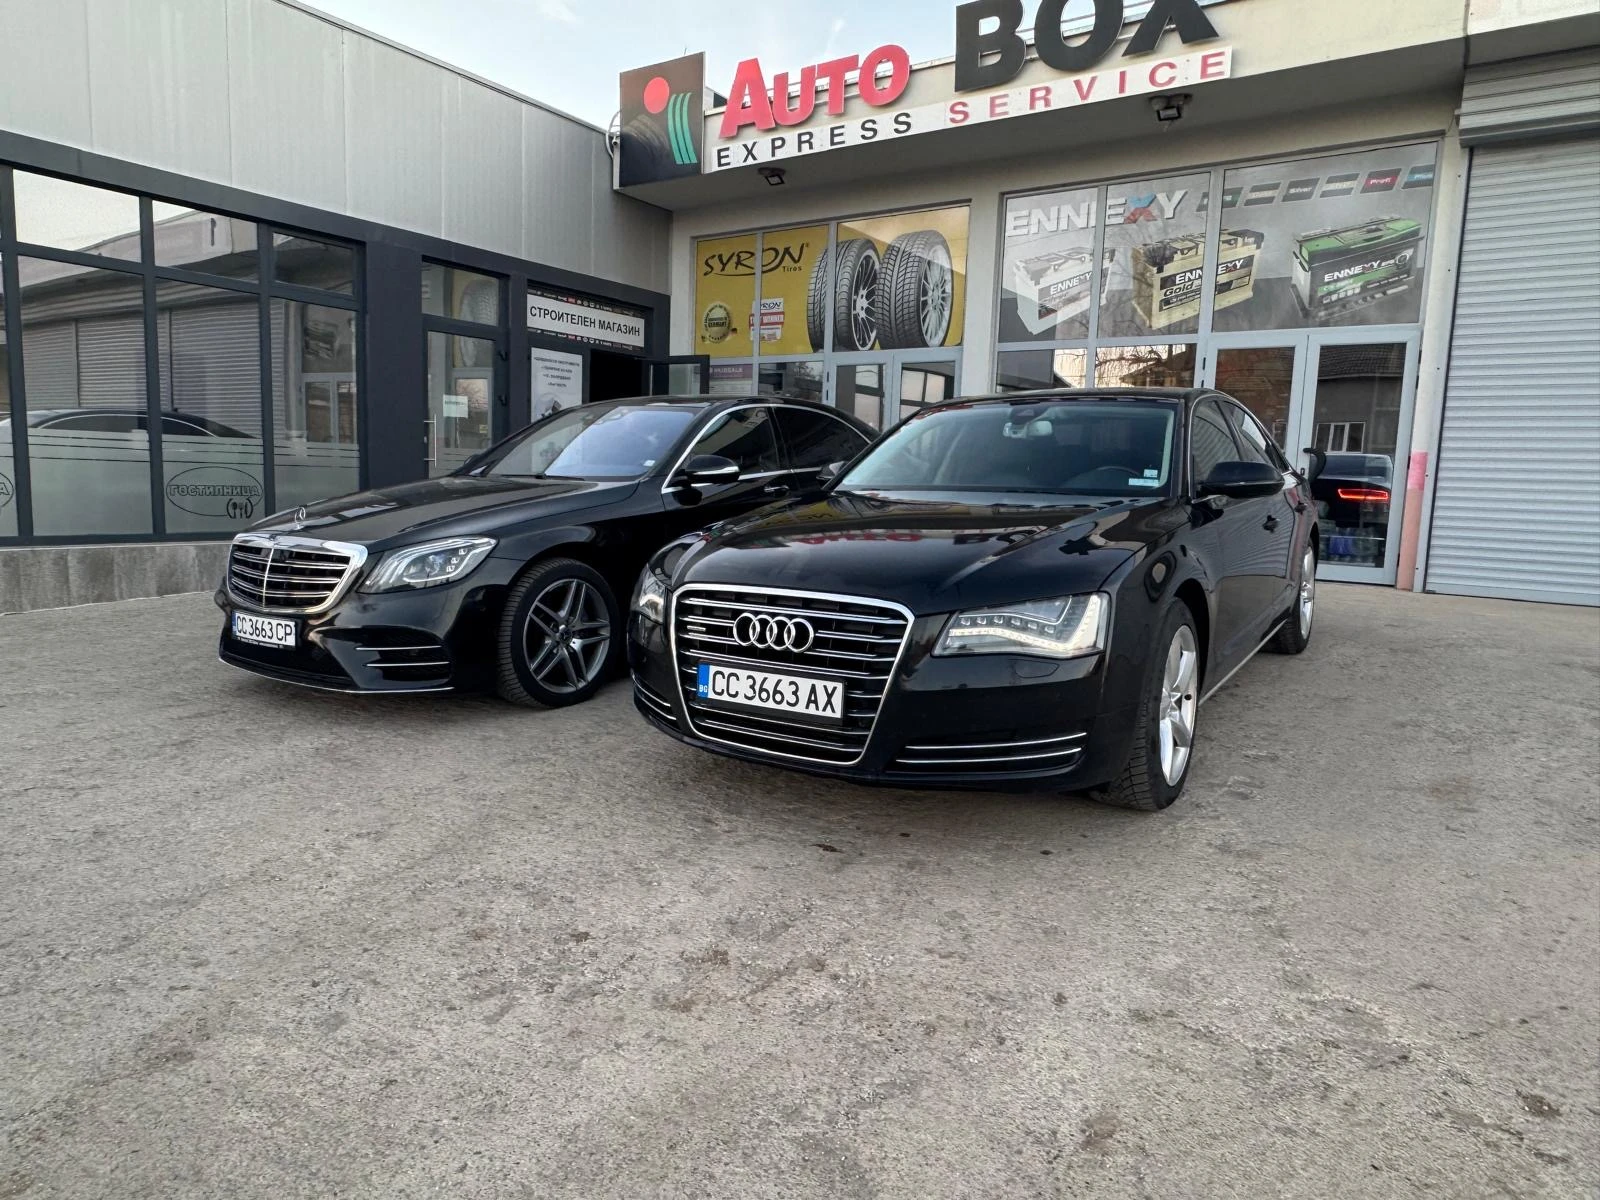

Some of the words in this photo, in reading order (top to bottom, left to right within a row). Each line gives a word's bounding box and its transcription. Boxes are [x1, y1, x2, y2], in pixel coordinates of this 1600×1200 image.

[720, 44, 910, 138] AUTO
[954, 0, 1219, 92] BOX
[716, 112, 912, 168] EXPRESS
[948, 50, 1227, 124] SERVICE
[703, 242, 805, 277] SYRON
[782, 265, 803, 273] Tires
[1324, 259, 1380, 282] ENNEXY
[1163, 281, 1193, 298] Gold
[529, 305, 596, 328] СТРОИТЕЛЕН
[598, 319, 640, 336] МАГАЗИН
[168, 484, 261, 497] ГОСТИЛНИЦА
